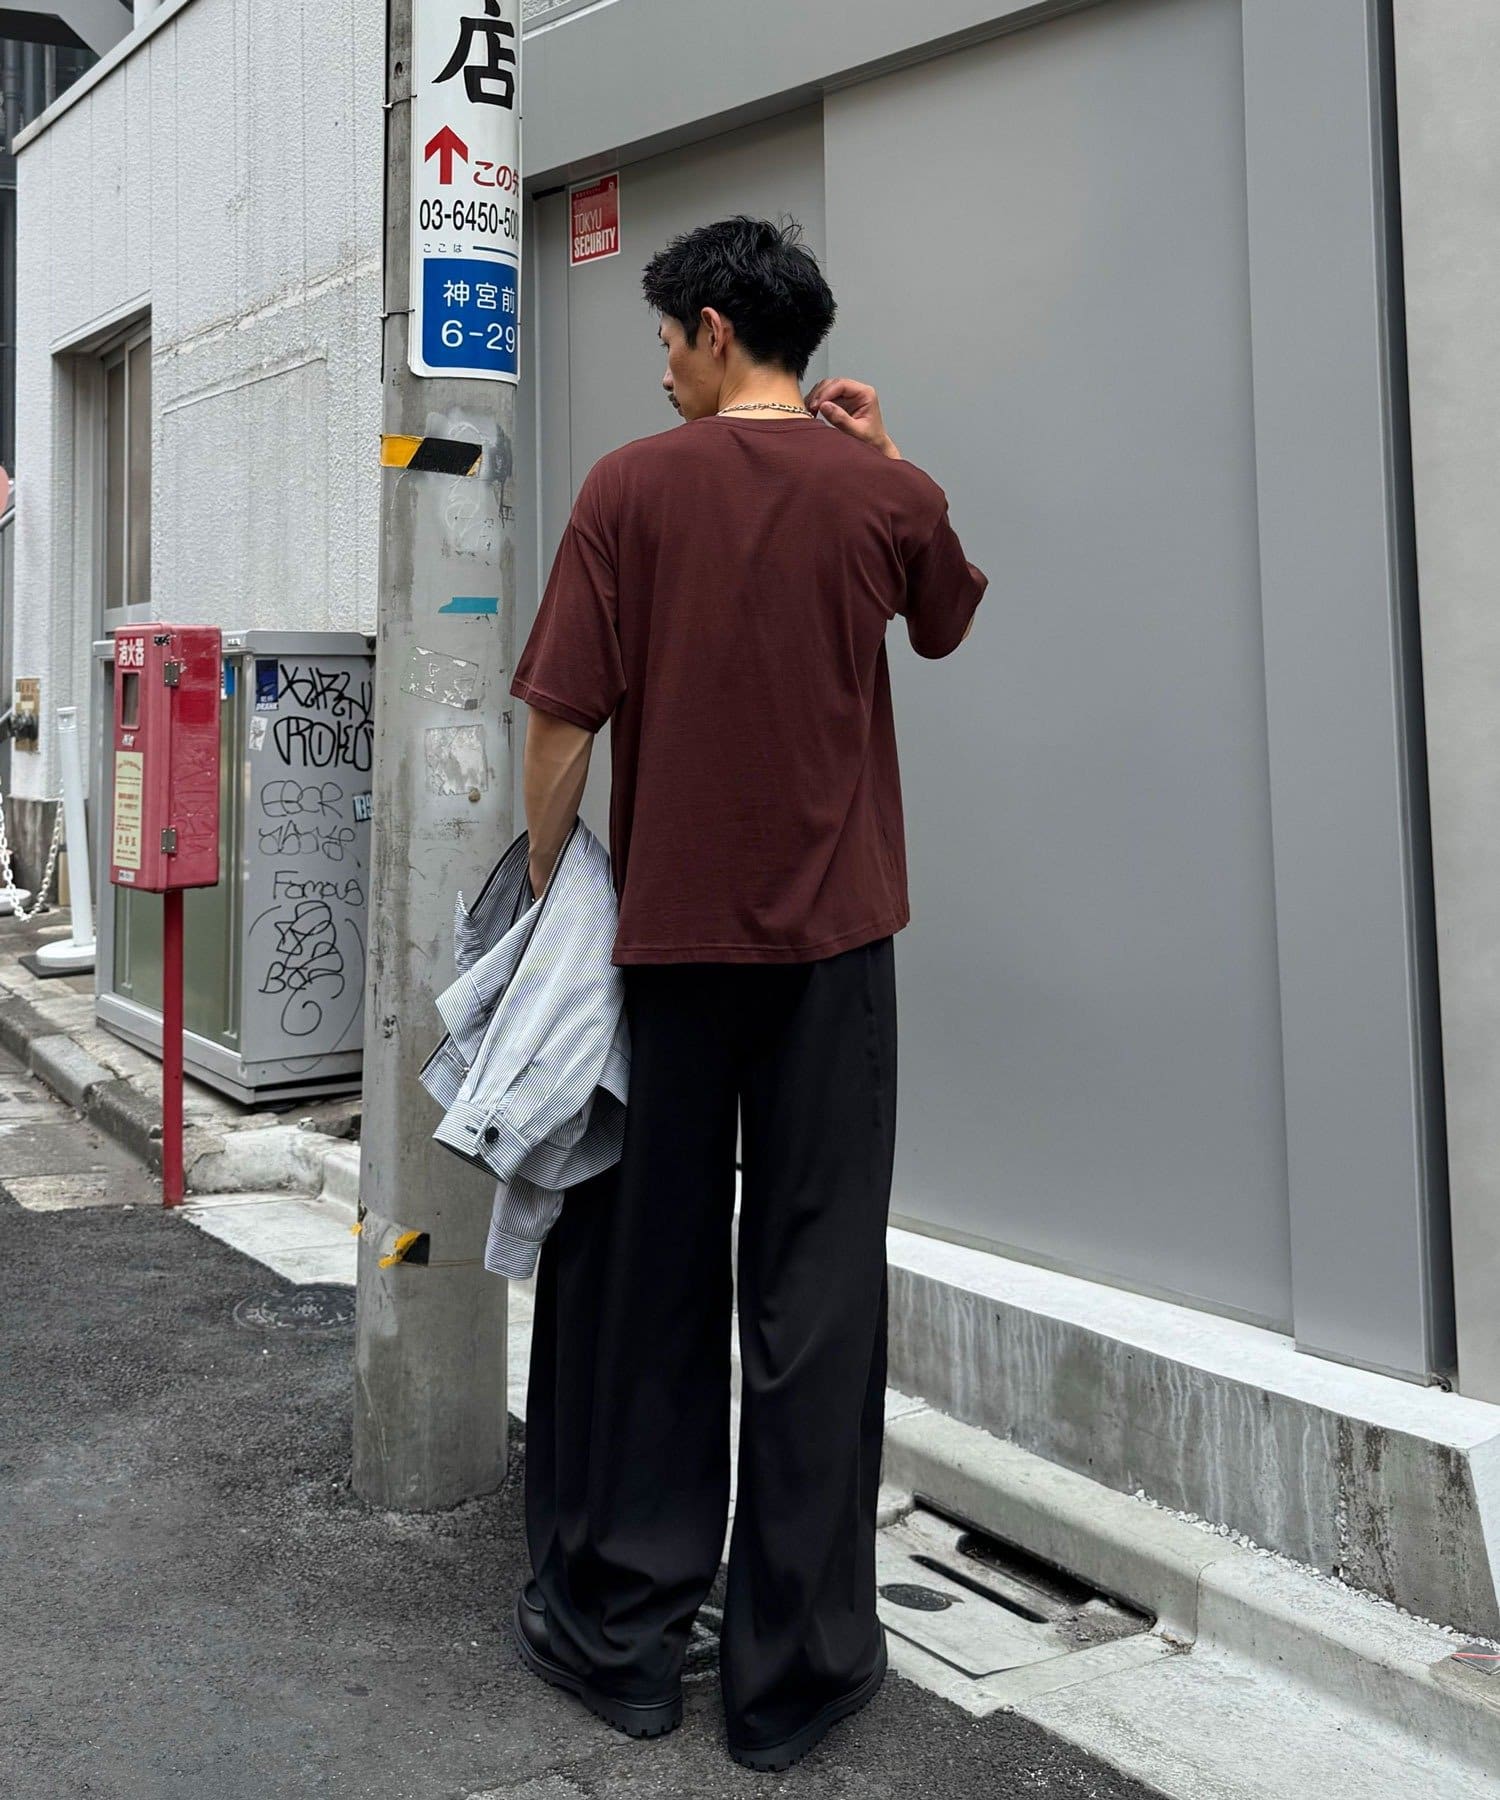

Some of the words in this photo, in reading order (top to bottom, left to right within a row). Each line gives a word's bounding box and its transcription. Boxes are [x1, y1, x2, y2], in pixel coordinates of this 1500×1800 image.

[432, 0, 516, 110] 店
[574, 207, 603, 235] TOKYU
[423, 243, 462, 253] ここは
[574, 226, 617, 258] SECURITY
[443, 280, 515, 314] 神宮前
[441, 320, 515, 353] 6-29
[118, 638, 144, 667] 消火器
